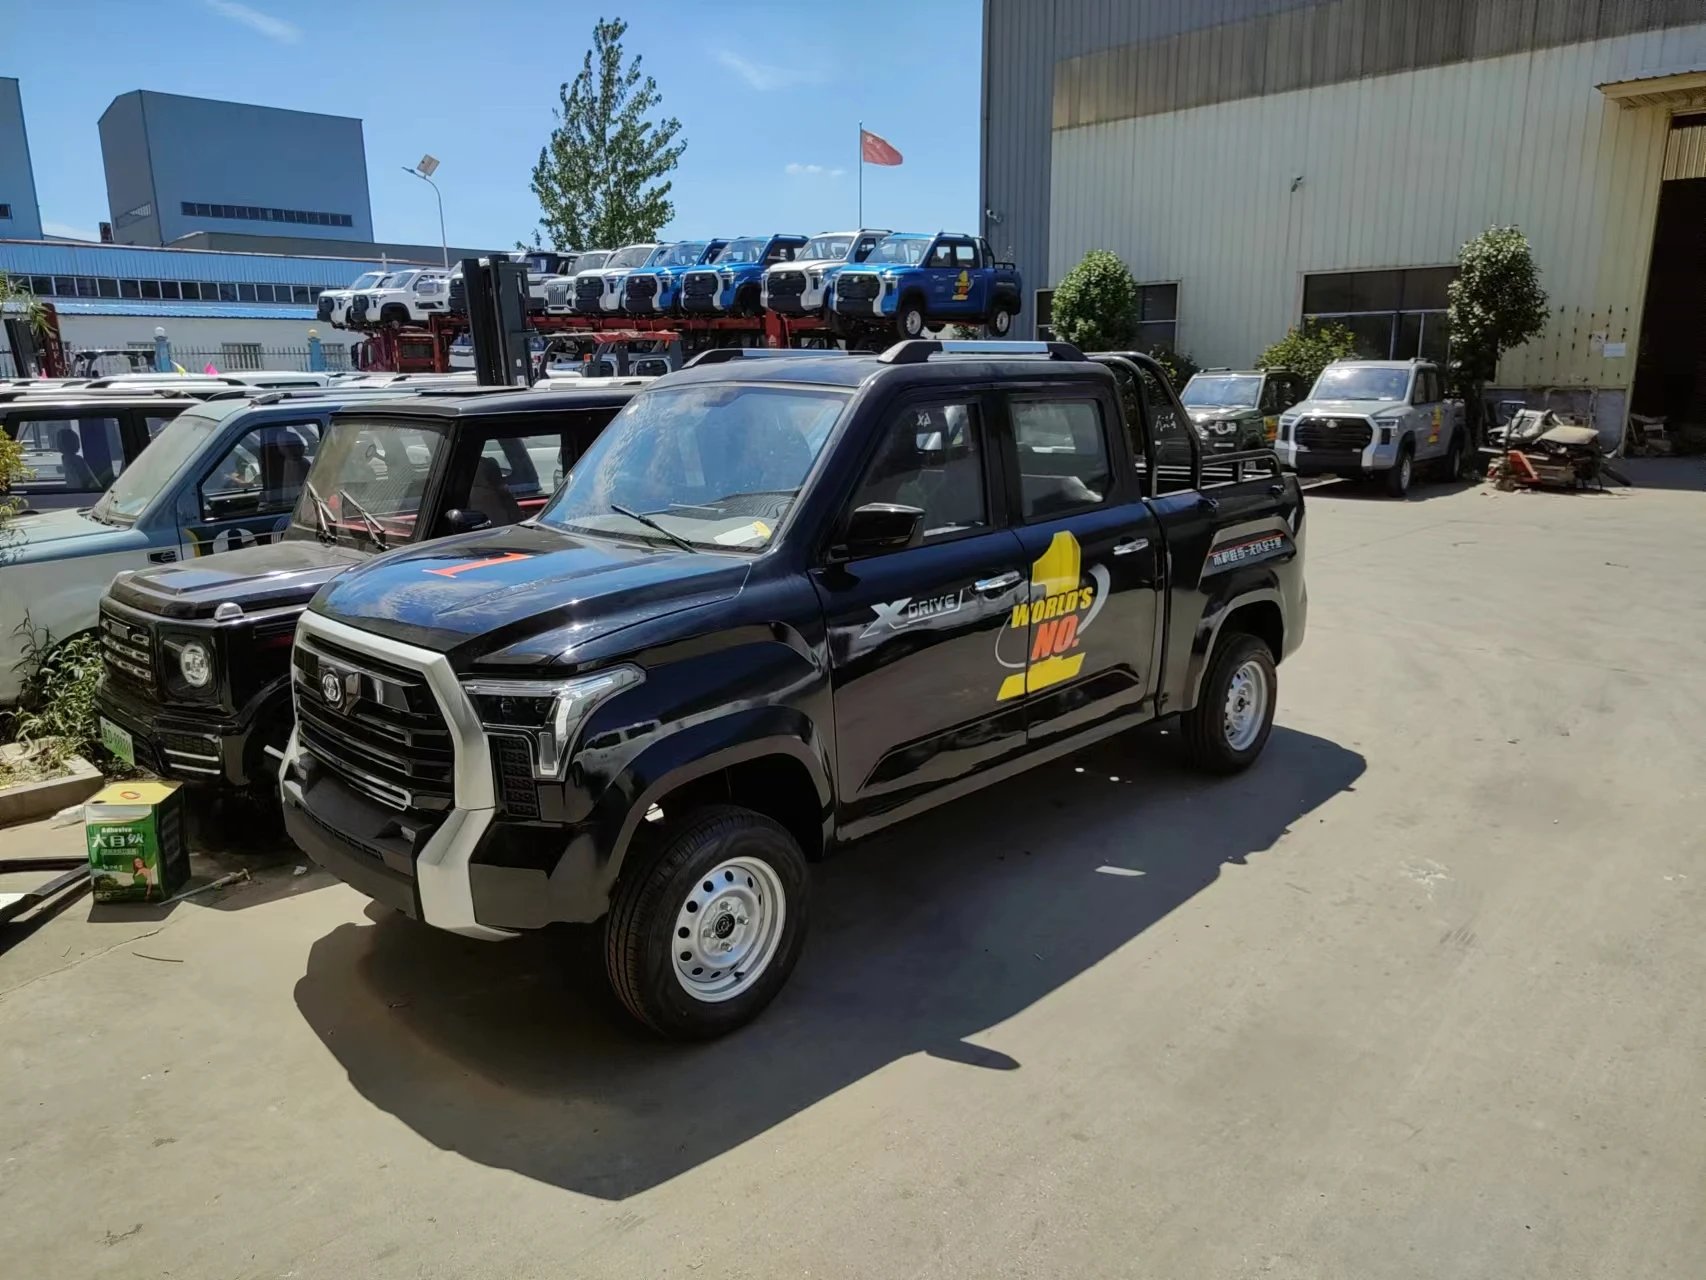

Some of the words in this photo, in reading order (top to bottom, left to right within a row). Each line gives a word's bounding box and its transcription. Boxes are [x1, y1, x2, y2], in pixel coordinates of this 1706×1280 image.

[858, 597, 912, 639] X
[907, 594, 956, 619] DRIVE
[1010, 586, 1094, 629] WORLD'S
[1031, 614, 1080, 661] NO.
[90, 832, 145, 849] 大自然
